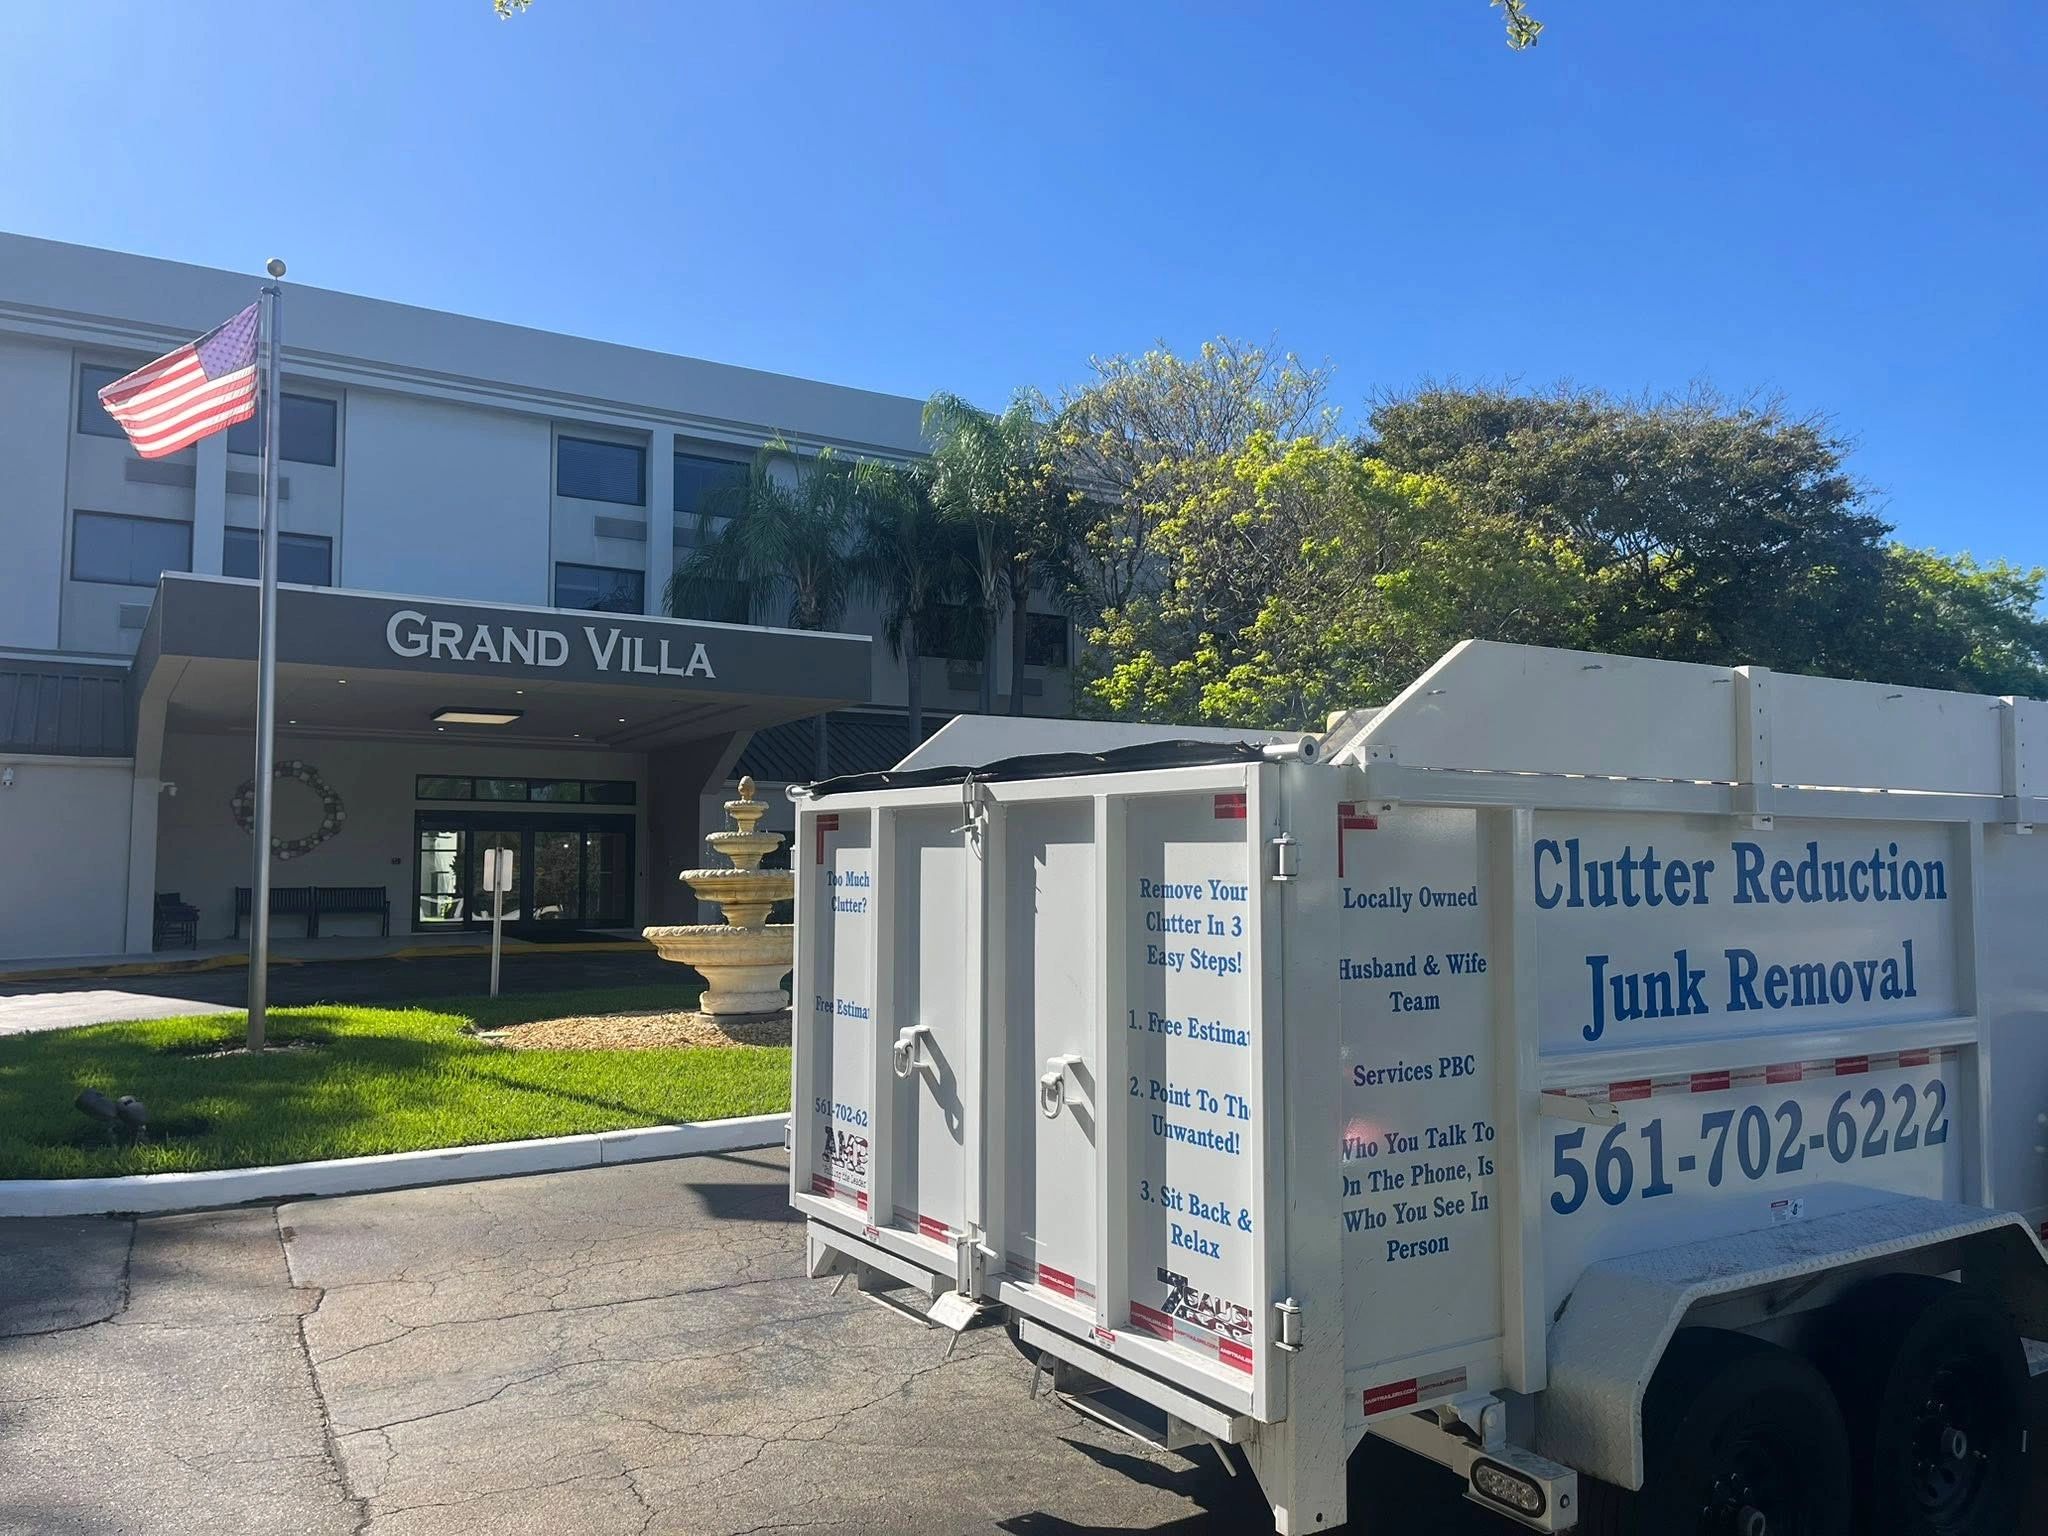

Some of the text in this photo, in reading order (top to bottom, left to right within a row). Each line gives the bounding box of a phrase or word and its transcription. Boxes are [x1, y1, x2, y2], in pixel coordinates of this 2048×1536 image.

[386, 610, 716, 679] GRAND VILLA
[827, 870, 870, 887] Too Much
[1534, 838, 1947, 909] Clutter Reduction
[832, 896, 867, 913] Clutter?
[1139, 878, 1248, 901] Remove Your
[1343, 886, 1478, 913] Locally Owned
[1146, 911, 1243, 937] Clutter In 3
[1147, 945, 1242, 977] Easy Steps!
[1339, 952, 1488, 980] Husband & Wife
[816, 996, 834, 1013] Free
[1389, 991, 1440, 1013] Team
[1582, 939, 1917, 1042] Junk Removal
[1128, 1009, 1142, 1031] 1.
[1147, 1011, 1182, 1036] Free
[1353, 1055, 1475, 1086] Services PBC
[1129, 1076, 1144, 1098] 2.
[1150, 1080, 1191, 1109] Point
[1196, 1089, 1218, 1114] To
[815, 1097, 868, 1127] 561-702-62
[1151, 1114, 1240, 1156] Unwanted!
[1385, 1132, 1419, 1155] You
[1425, 1124, 1467, 1149] Talk
[1472, 1121, 1495, 1142] To
[1549, 1079, 1949, 1215] 561-702-6222
[1368, 1168, 1405, 1193] The
[1411, 1162, 1471, 1187] Phone,
[1478, 1156, 1494, 1177] Is
[1140, 1180, 1252, 1233] 3. Sit Back &
[1343, 1191, 1489, 1232] Who You See In
[1171, 1223, 1220, 1259] Relax
[1386, 1236, 1450, 1262] Person
